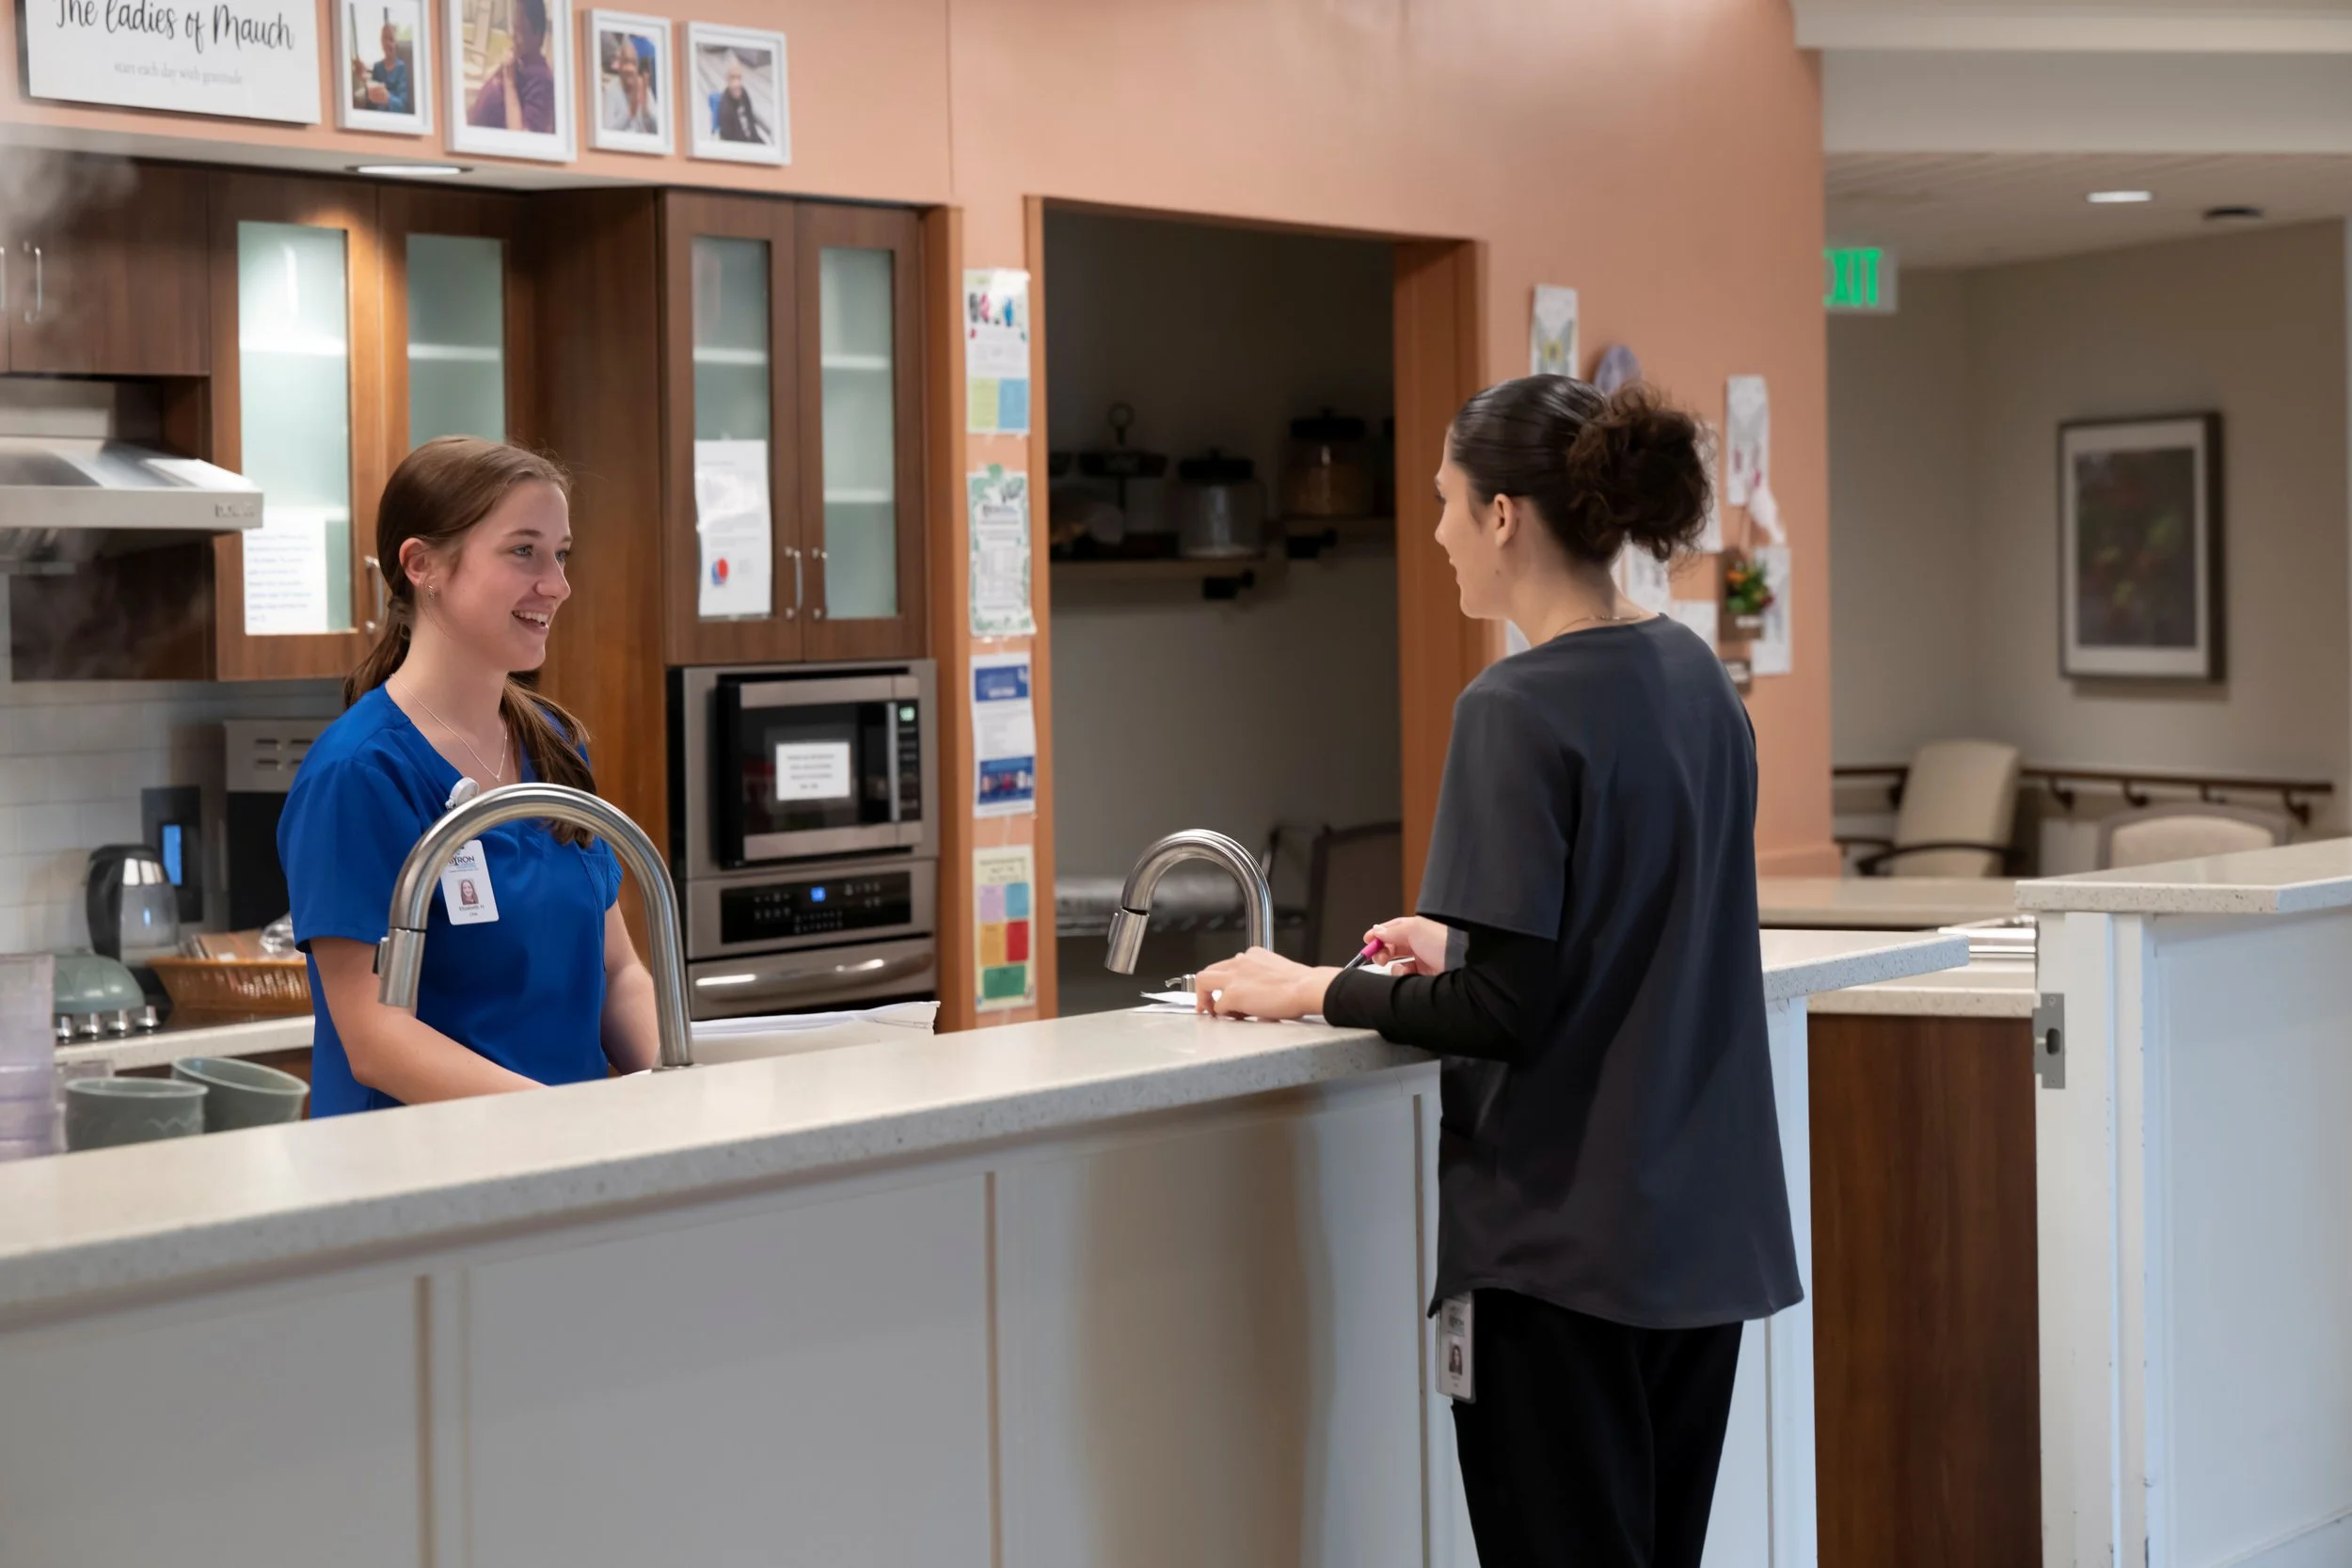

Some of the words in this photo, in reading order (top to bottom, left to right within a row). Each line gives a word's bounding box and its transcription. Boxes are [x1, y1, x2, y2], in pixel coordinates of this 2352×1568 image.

[184, 10, 206, 55] of
[213, 4, 294, 51] Mauch
[137, 60, 159, 76] each
